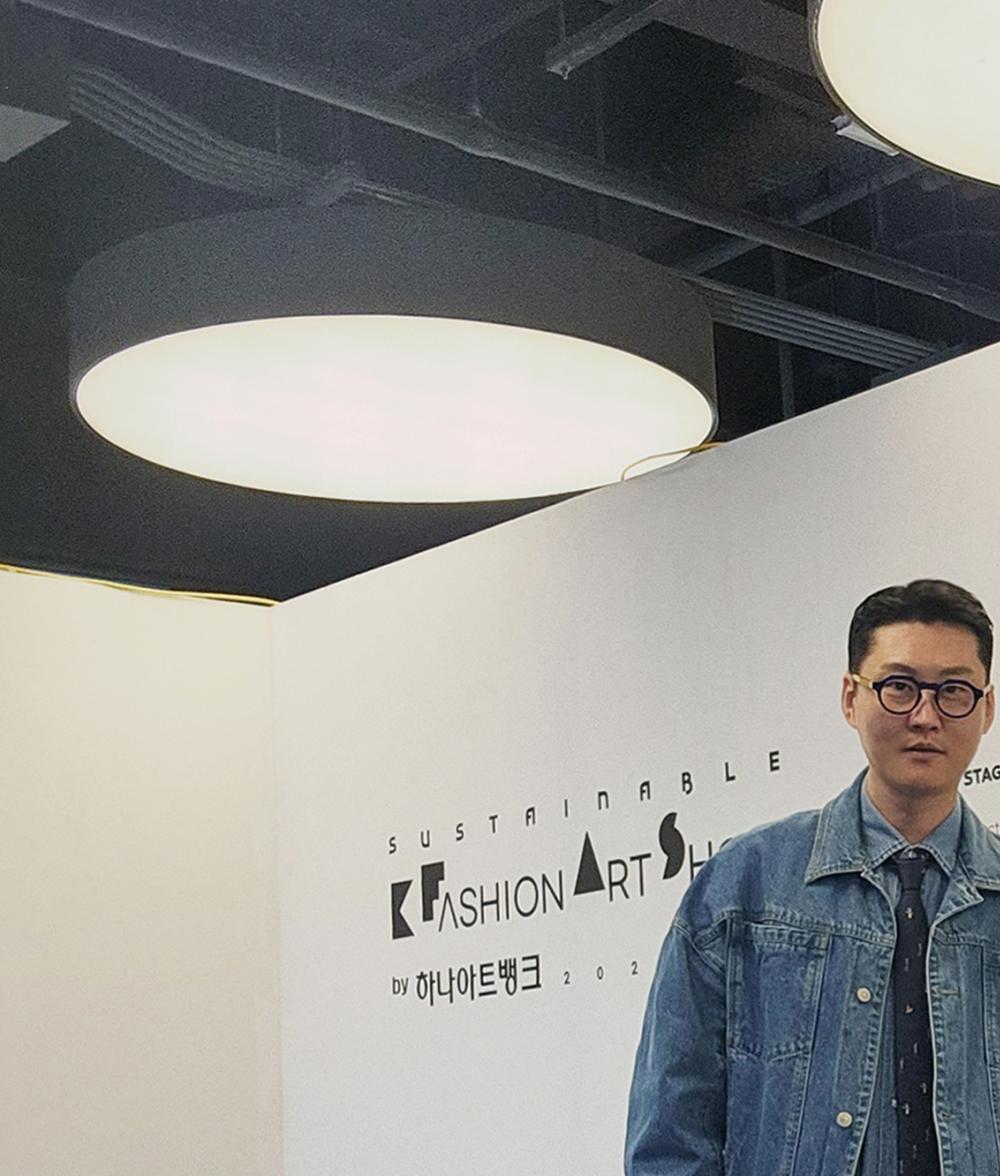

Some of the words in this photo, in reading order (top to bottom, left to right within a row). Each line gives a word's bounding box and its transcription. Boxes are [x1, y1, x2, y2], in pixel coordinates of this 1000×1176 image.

[658, 812, 733, 881] SH
[391, 976, 410, 997] by
[415, 953, 542, 1007] 하나아트뱅크
